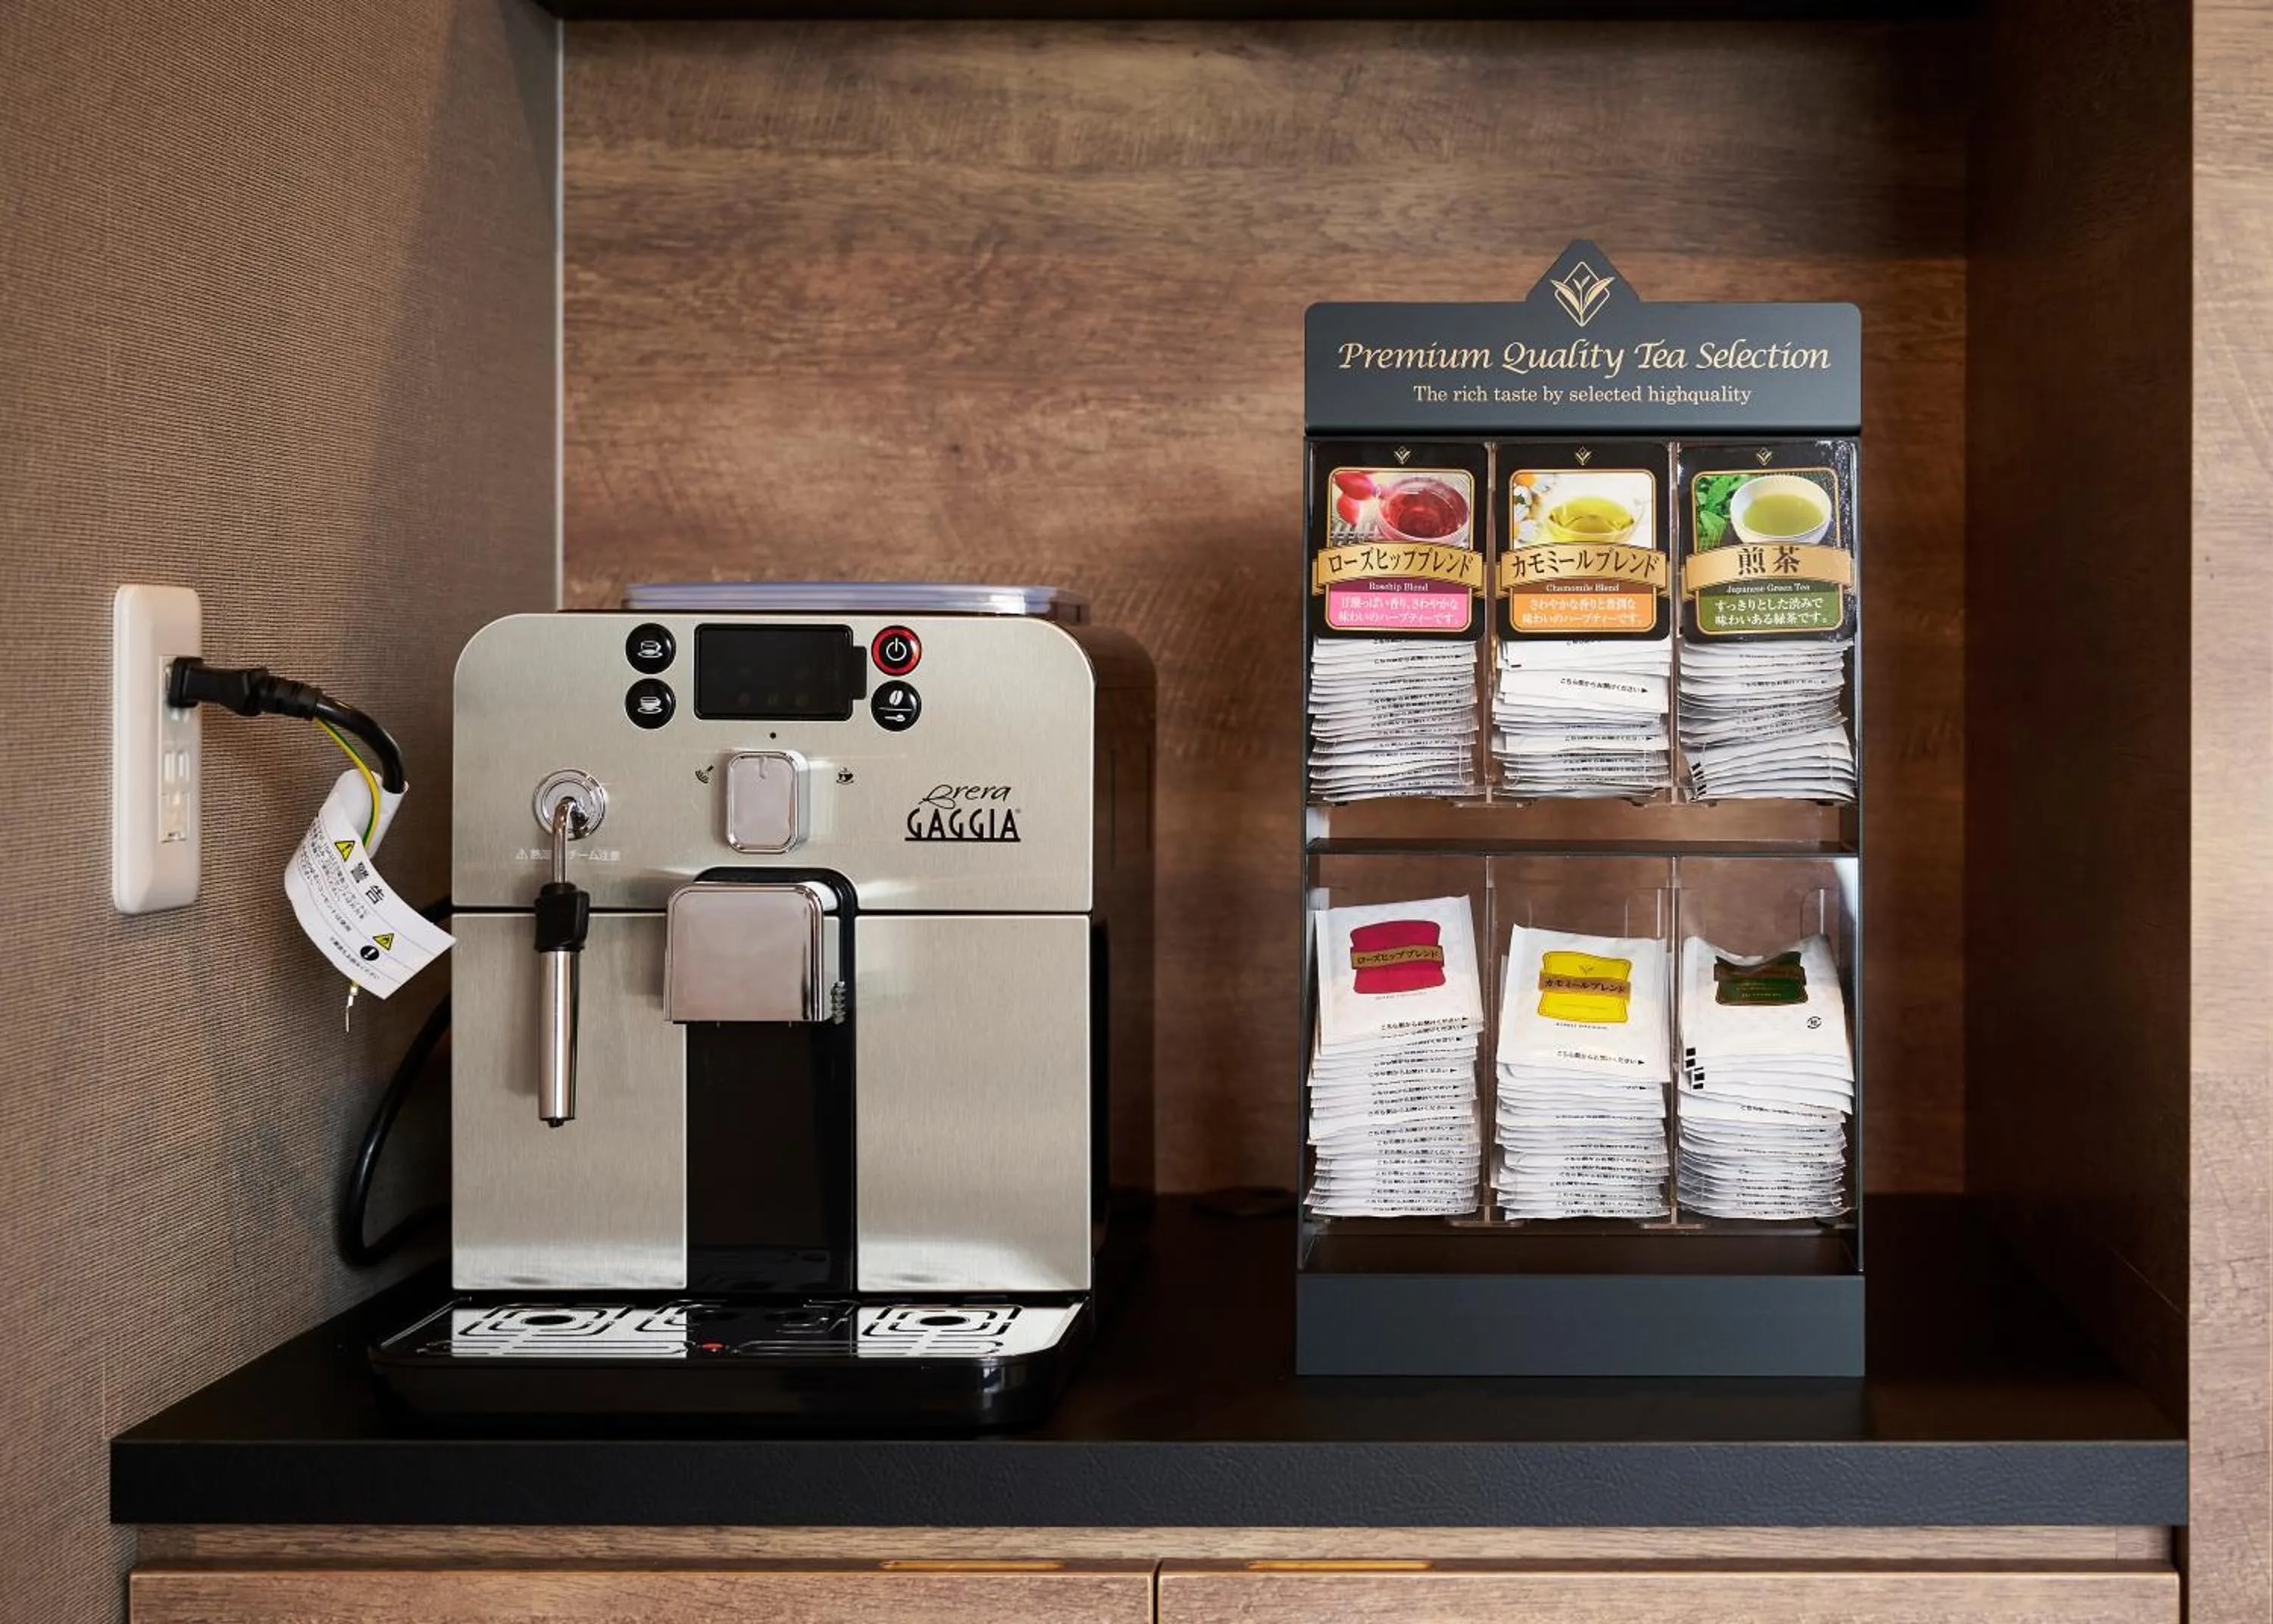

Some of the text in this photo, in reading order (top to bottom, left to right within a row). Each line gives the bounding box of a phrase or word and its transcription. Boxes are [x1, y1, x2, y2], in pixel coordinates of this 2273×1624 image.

[1338, 339, 1831, 379] Premium Quality Tea Selection
[1413, 385, 1752, 405] The rich taste by selected highquality
[1328, 546, 1474, 578] ローズヒップブレンド
[1512, 547, 1662, 579] カモミールブレンド
[1737, 545, 1801, 576] 煎茶
[1369, 582, 1428, 592] Rosehip Blend
[1546, 583, 1620, 592] Chamomile Blend
[1726, 582, 1811, 595] Japanese Green Tea
[906, 807, 1021, 842] GAGGIA
